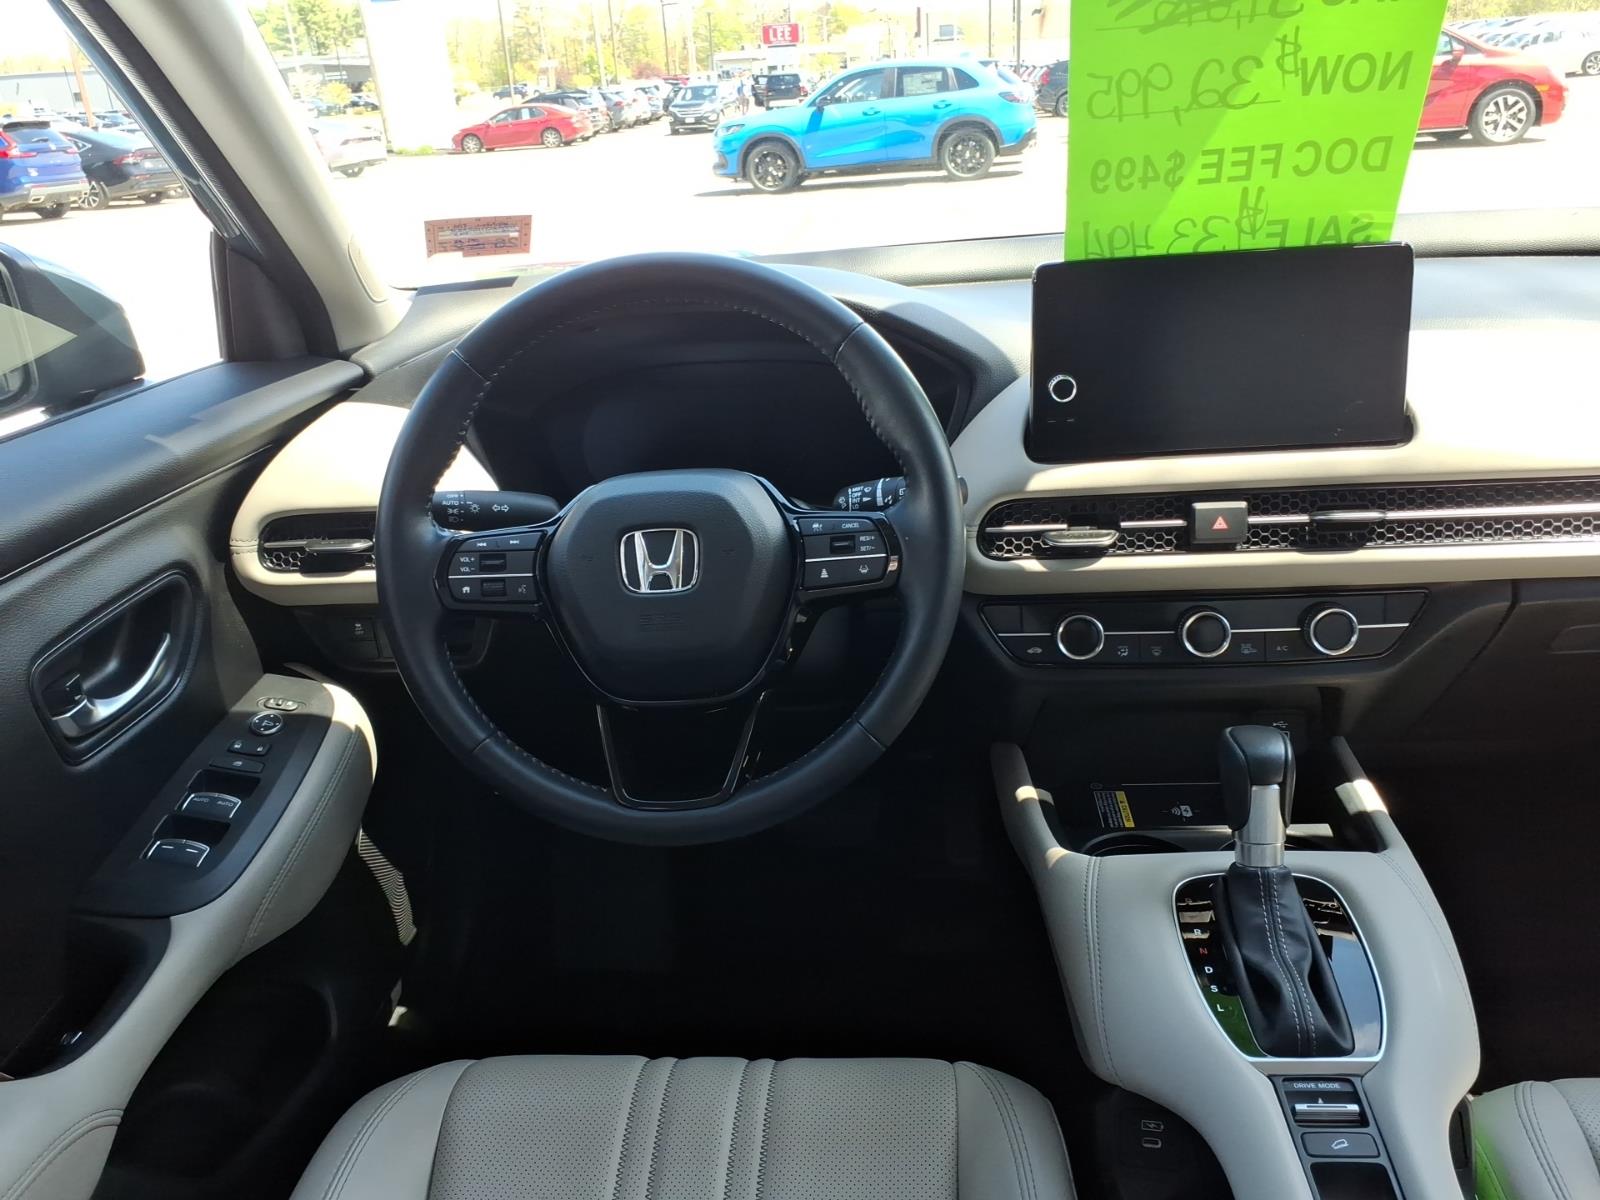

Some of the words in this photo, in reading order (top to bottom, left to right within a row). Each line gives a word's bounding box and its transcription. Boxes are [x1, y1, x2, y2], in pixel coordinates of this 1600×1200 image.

[769, 27, 793, 41] LEE
[1193, 928, 1202, 936] R
[1199, 947, 1208, 955] N
[1204, 966, 1213, 974] D
[1216, 1003, 1225, 1012] L
